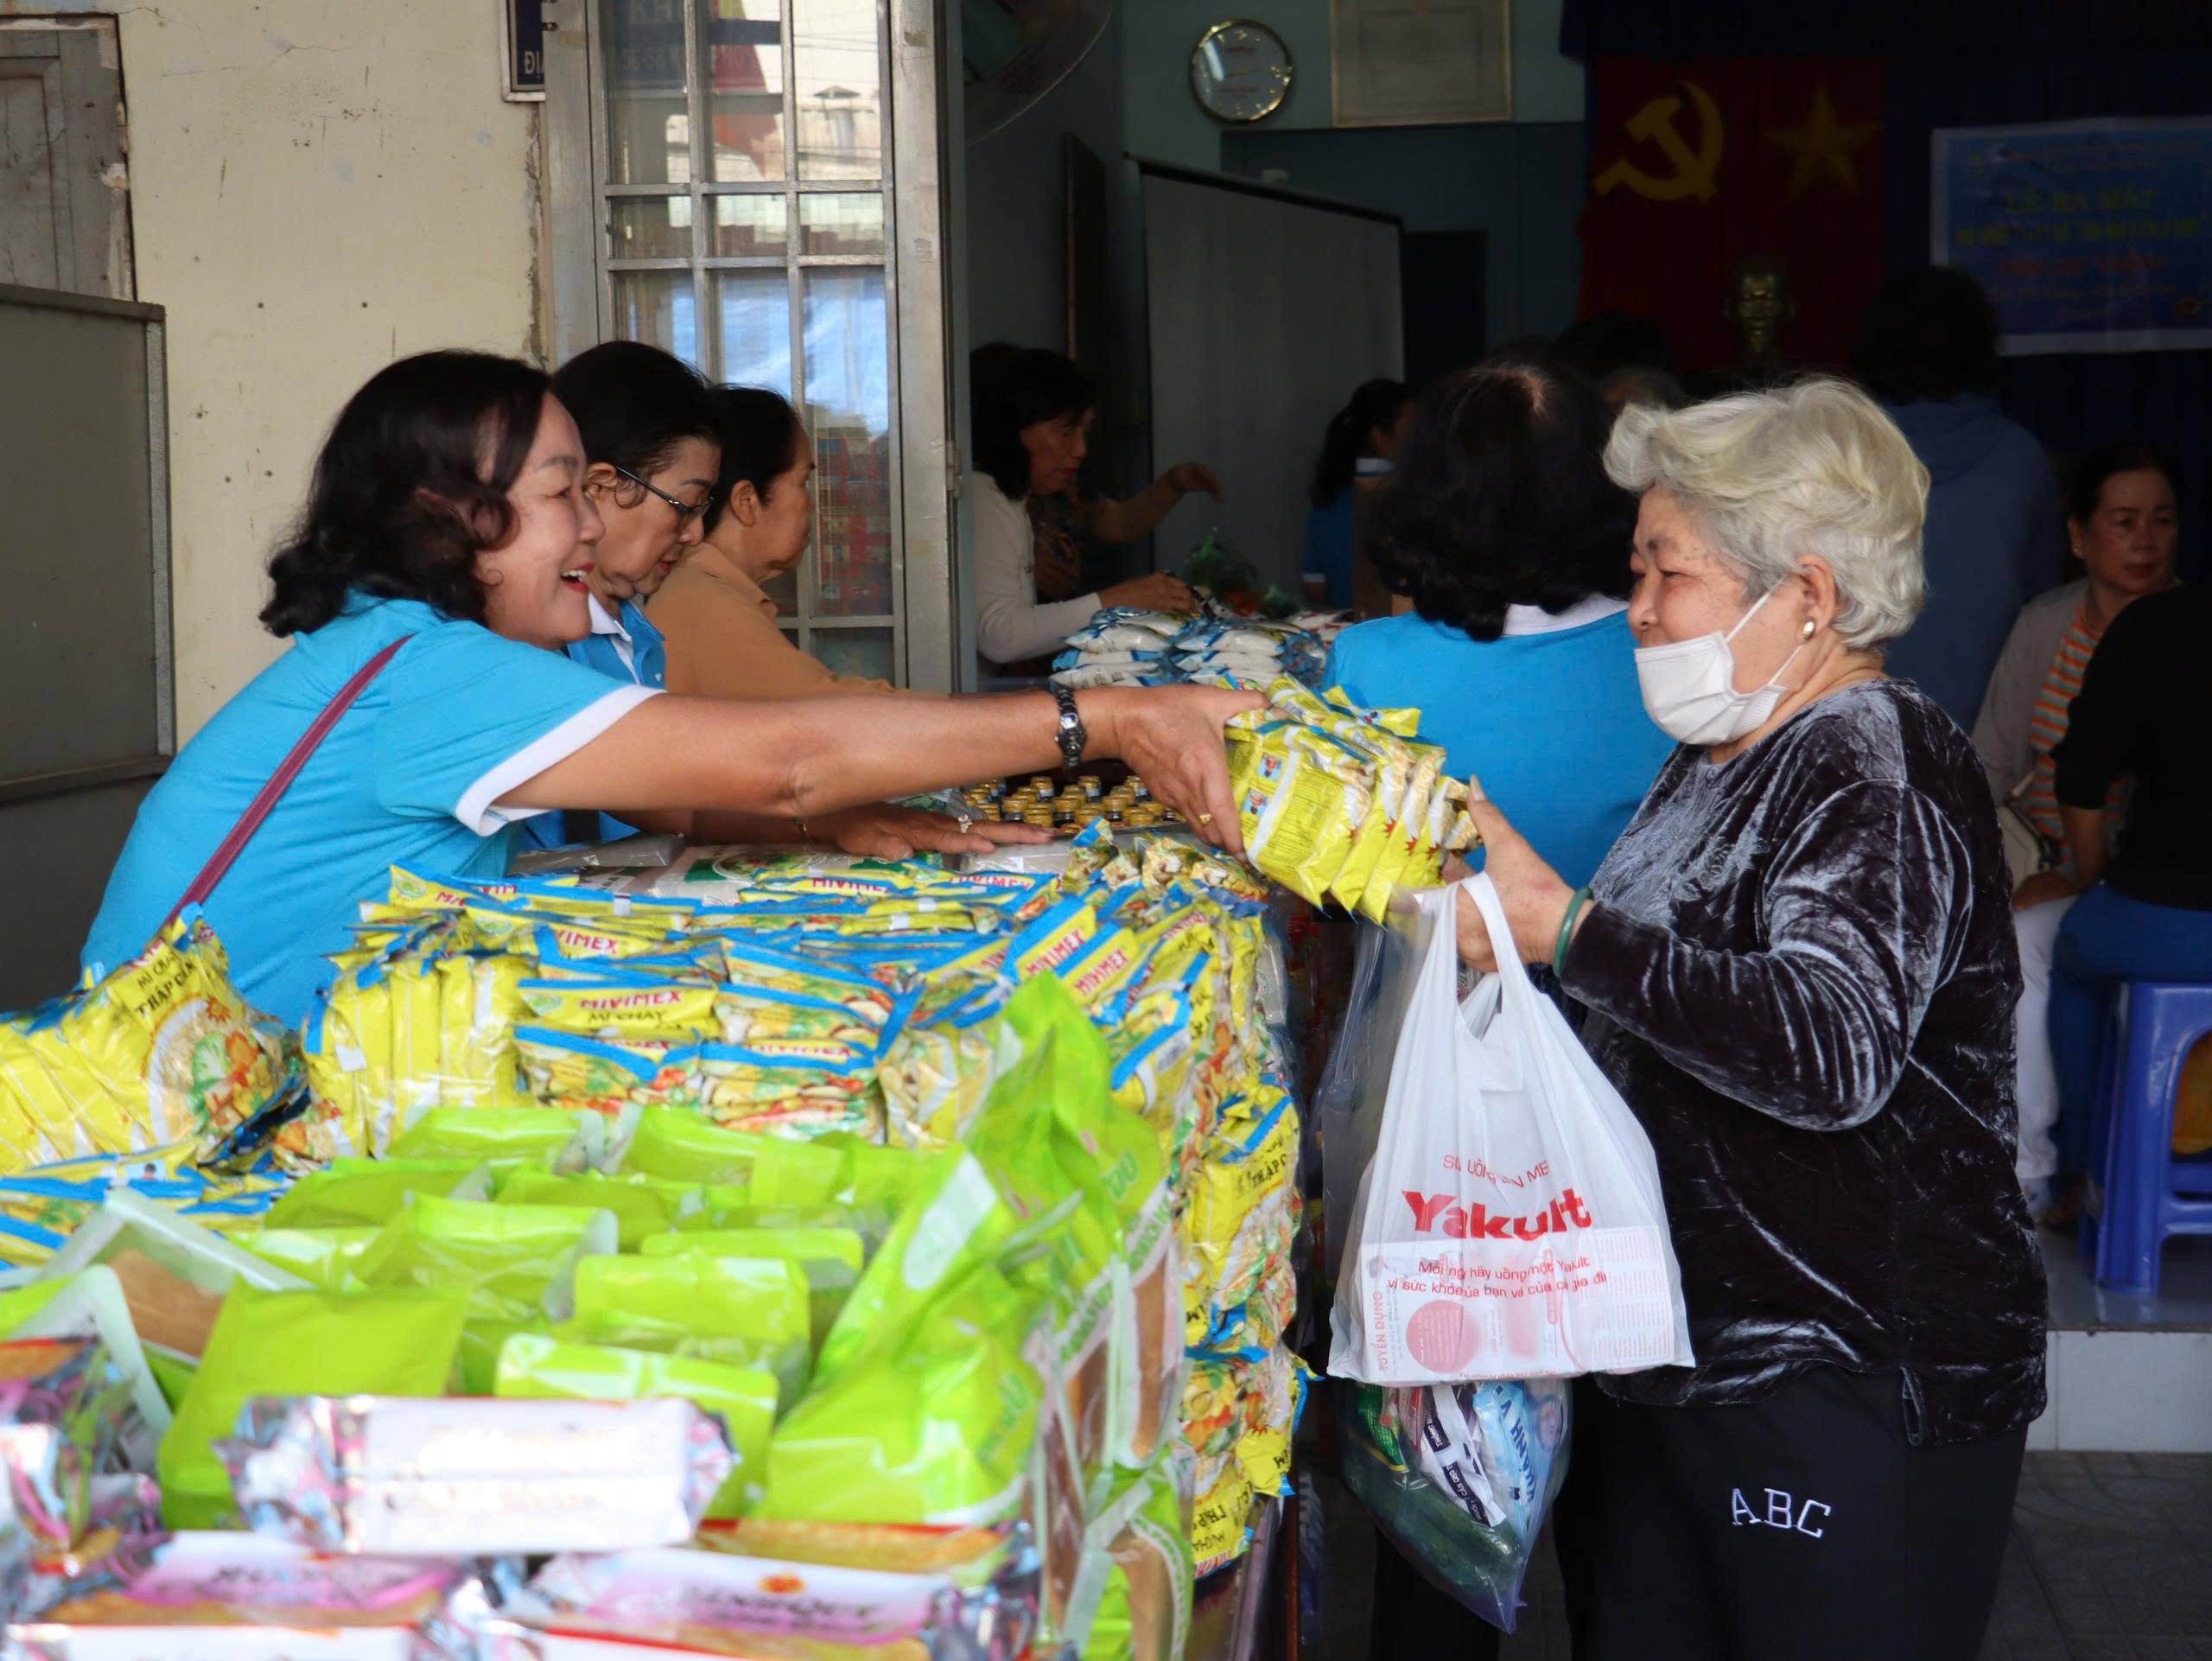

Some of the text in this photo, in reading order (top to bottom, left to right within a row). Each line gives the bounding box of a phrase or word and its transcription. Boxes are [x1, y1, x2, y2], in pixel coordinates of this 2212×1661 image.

[580, 990, 681, 1009] MIVIMEX
[1402, 1188, 1592, 1242] Yakult
[1732, 1487, 1832, 1538] ABC
